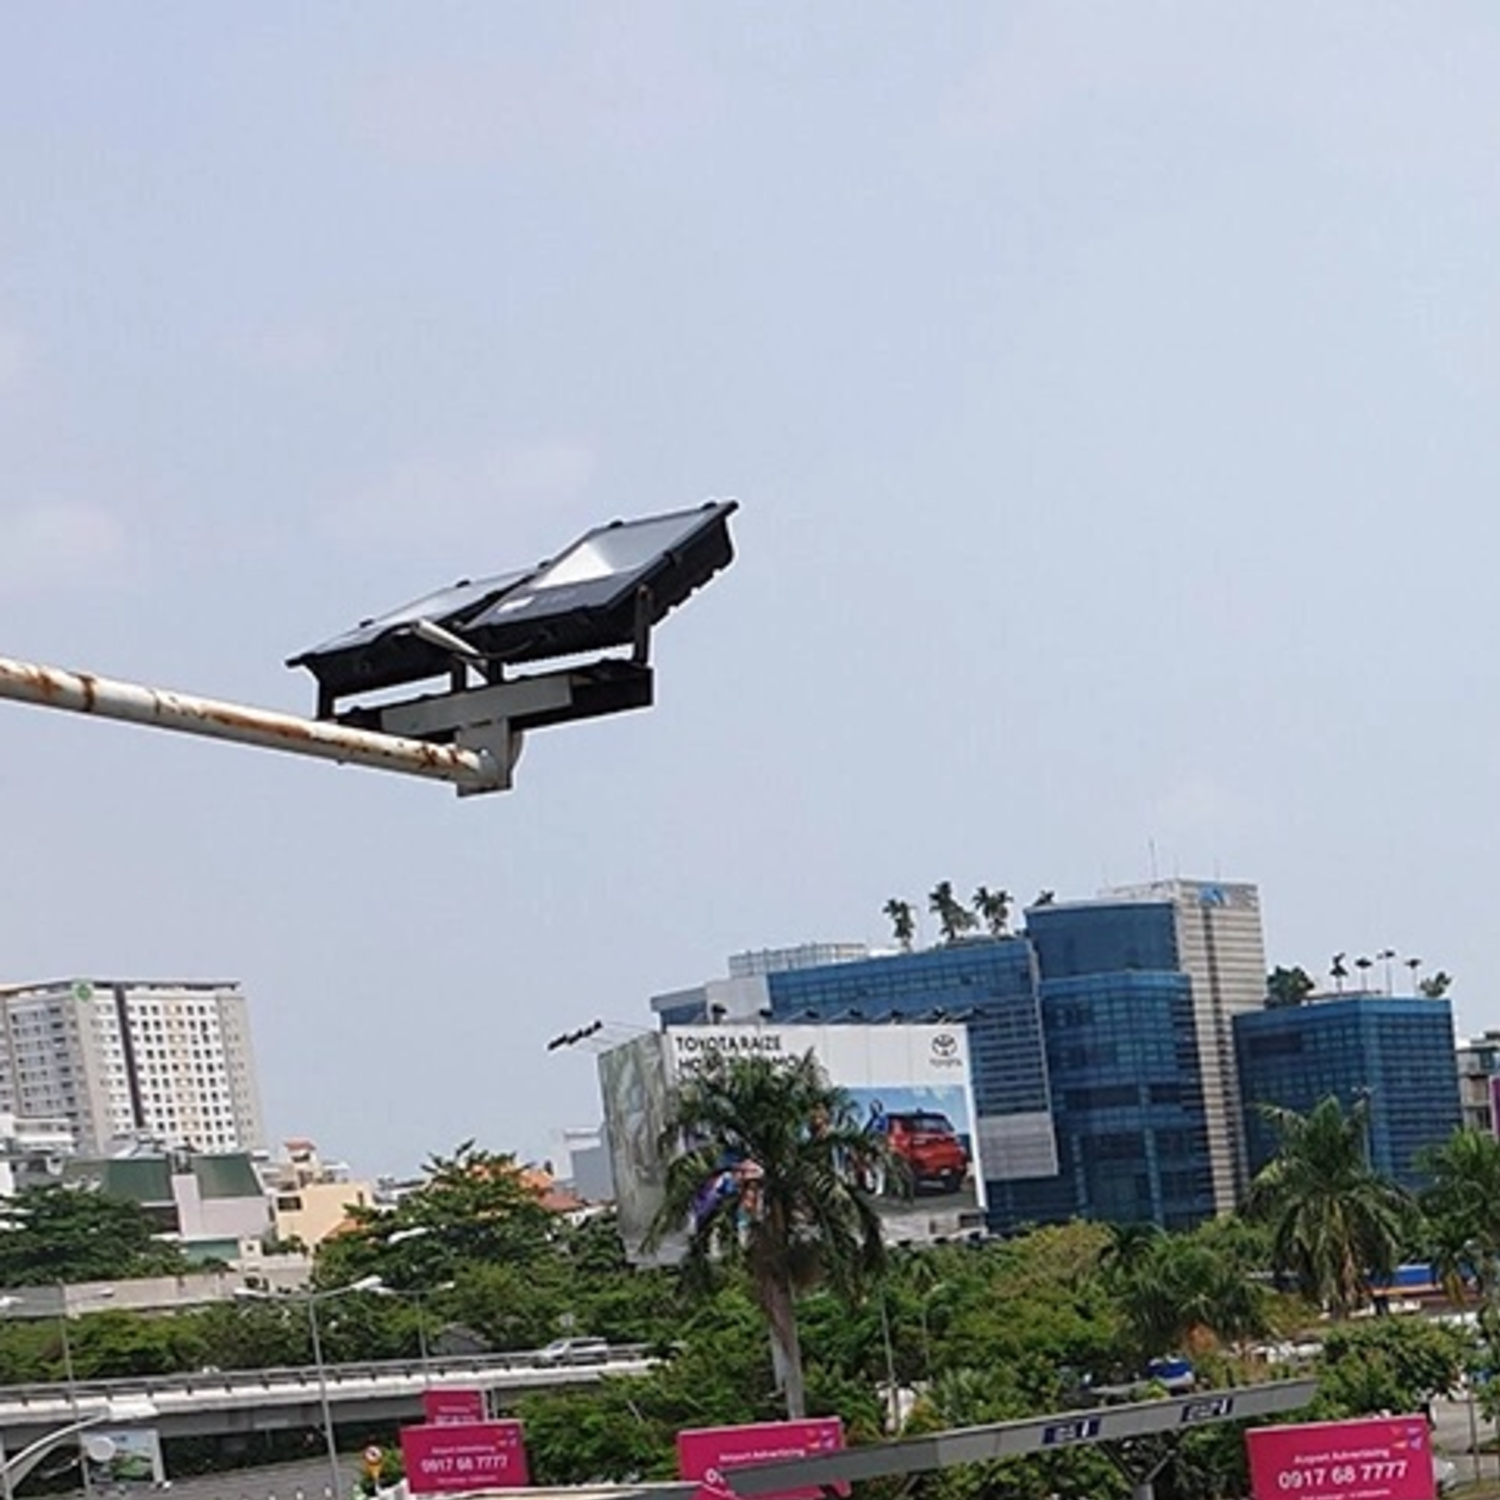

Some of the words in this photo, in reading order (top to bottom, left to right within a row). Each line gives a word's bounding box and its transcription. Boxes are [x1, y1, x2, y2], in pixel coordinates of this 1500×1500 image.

[676, 1036, 738, 1052] TOYOTA
[1294, 1453, 1330, 1465] Airport
[1332, 1449, 1391, 1463] Advertising
[1278, 1467, 1326, 1489] 0917
[1332, 1464, 1355, 1485] 68
[1361, 1460, 1408, 1482] 7777
